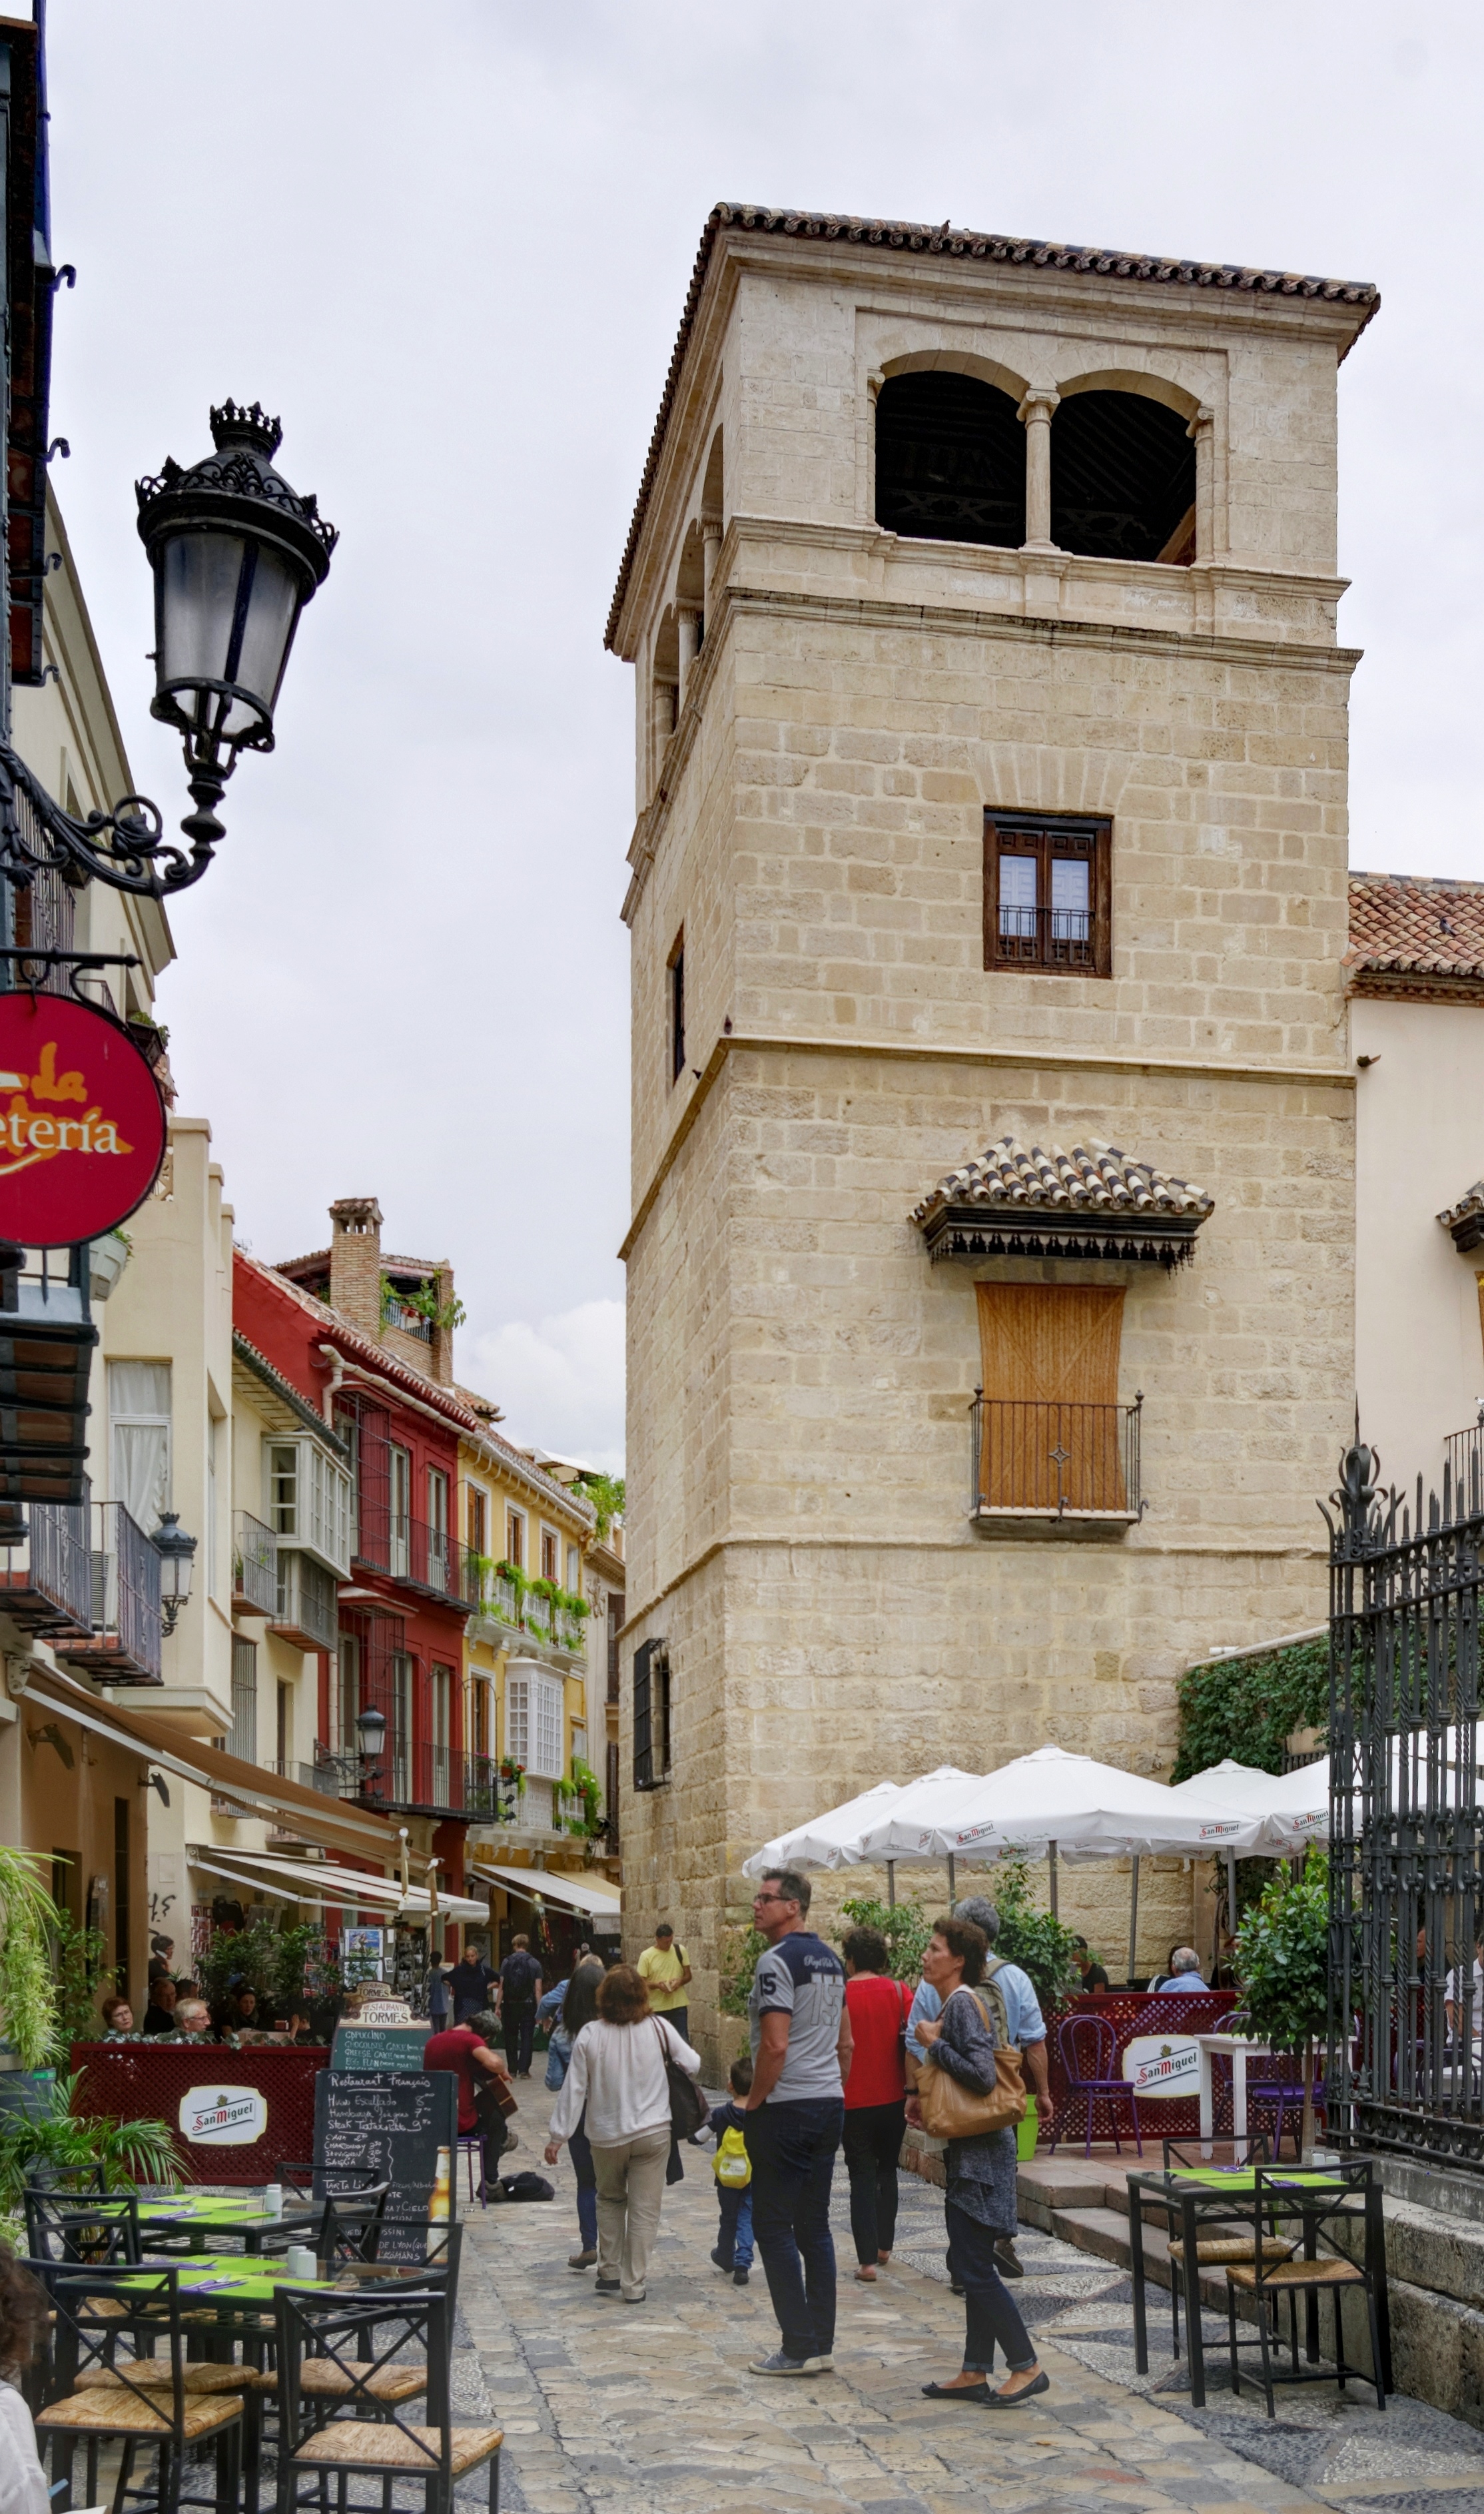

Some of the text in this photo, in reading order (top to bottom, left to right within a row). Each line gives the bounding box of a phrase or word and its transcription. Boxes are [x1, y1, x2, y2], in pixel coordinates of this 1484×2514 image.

[359, 1988, 389, 1998] TORMES
[363, 2002, 407, 2012] RESTAURANTE
[362, 2011, 408, 2024] TORMES
[328, 2072, 384, 2087] Restaurant
